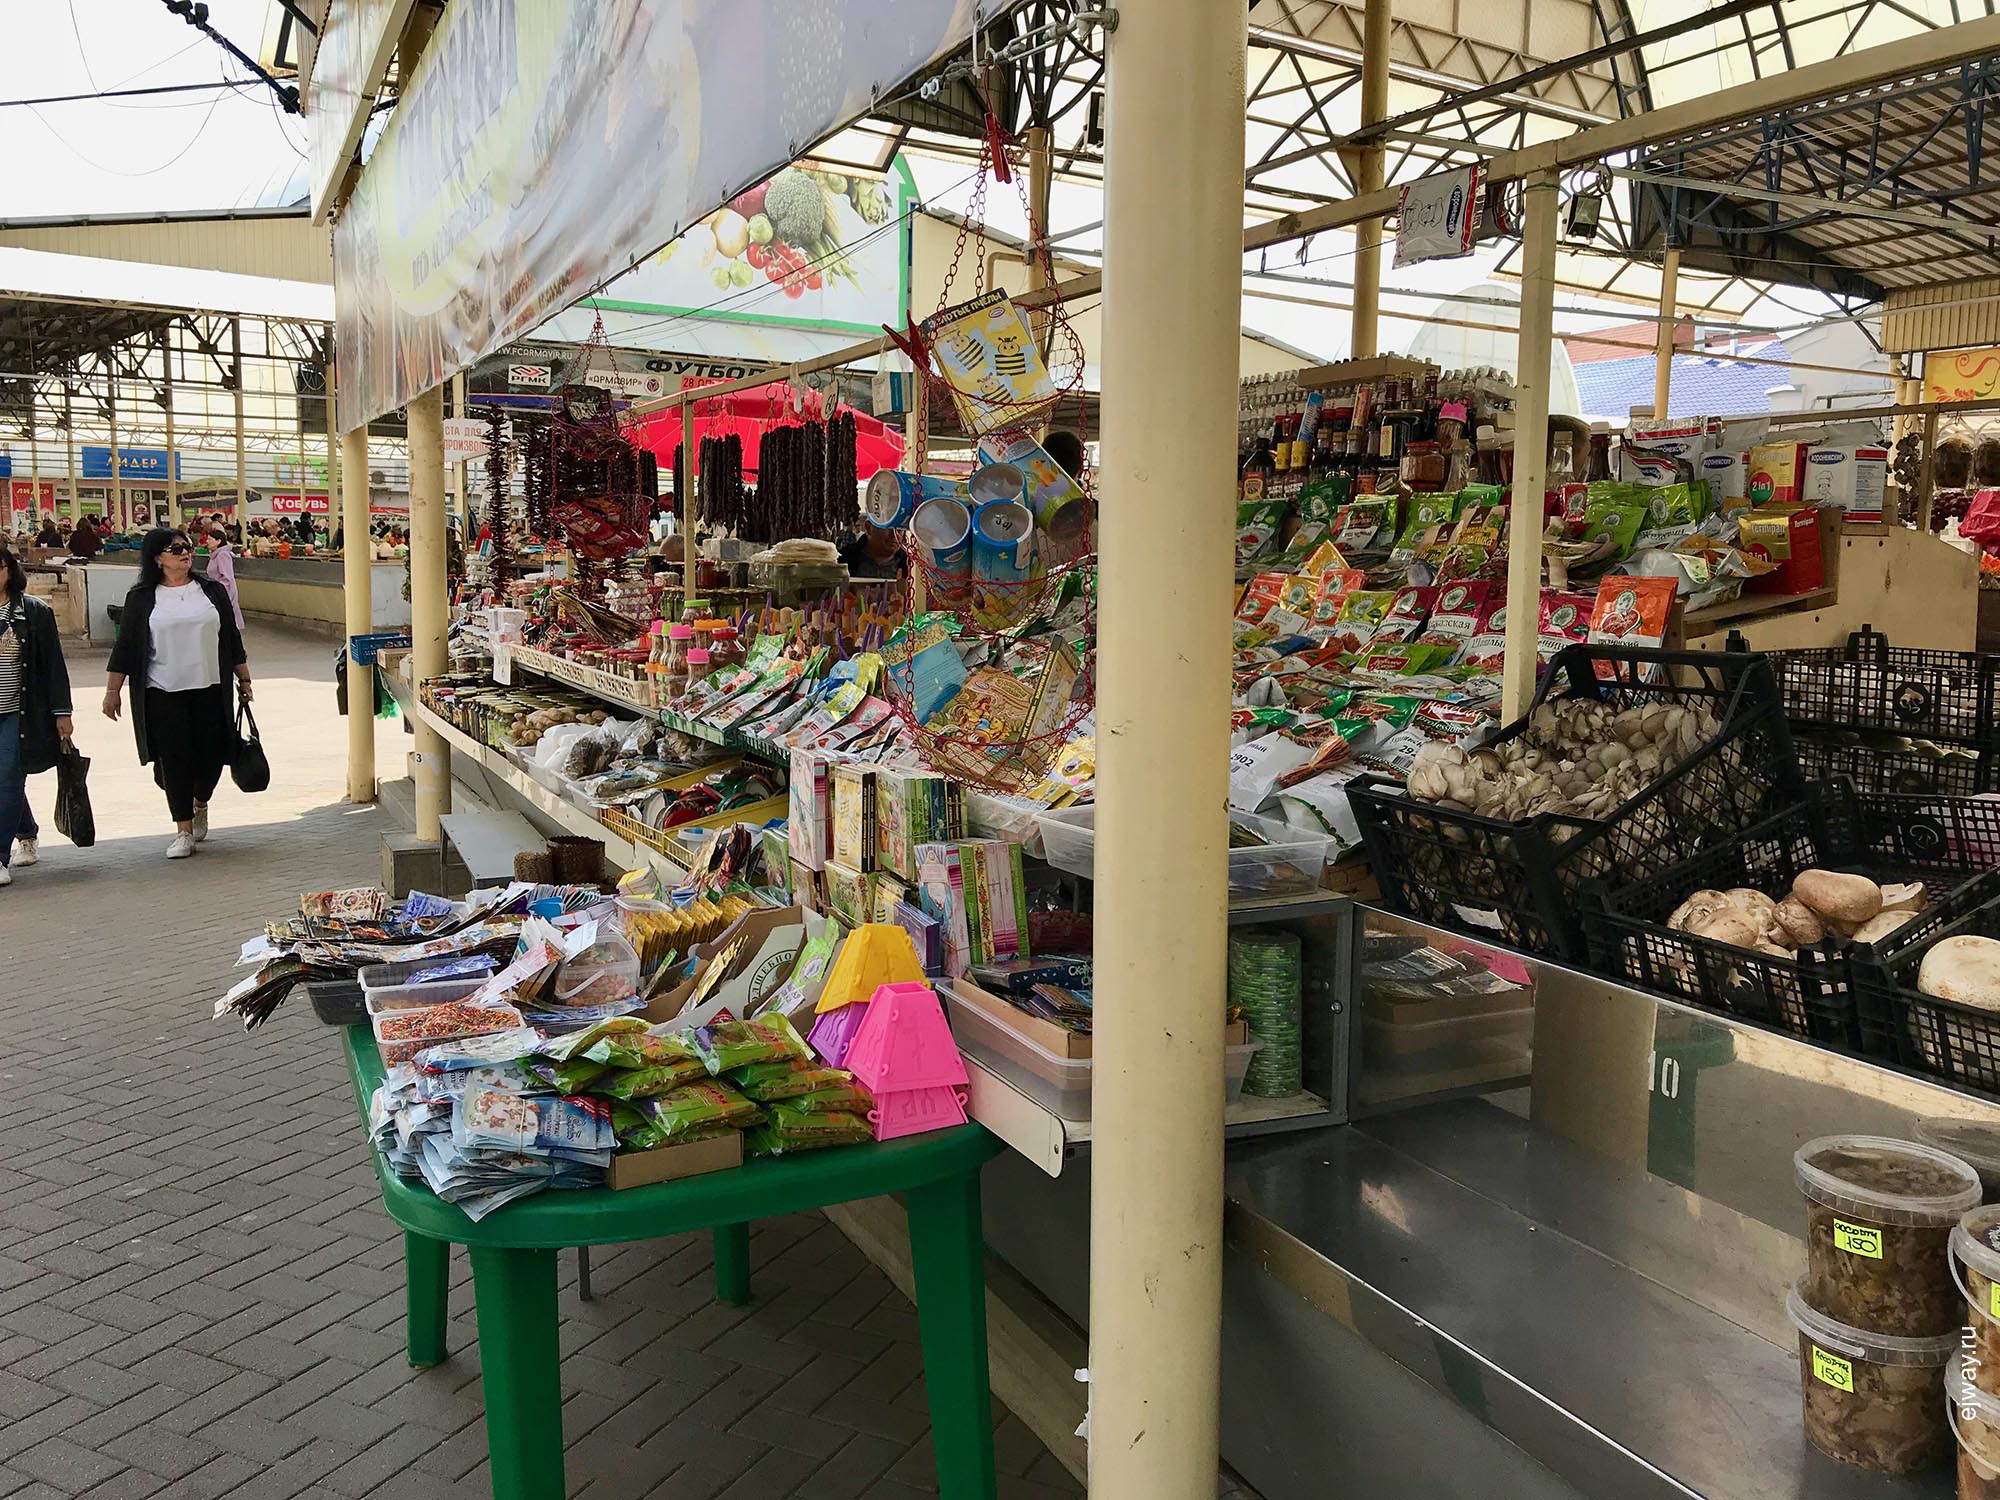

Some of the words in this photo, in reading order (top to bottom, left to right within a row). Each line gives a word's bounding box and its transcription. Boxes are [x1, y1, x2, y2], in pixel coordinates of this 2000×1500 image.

[511, 375, 547, 384] РГМК
[1752, 481, 1758, 492] 2
[416, 753, 422, 763] 3
[1648, 1050, 1680, 1099] 10
[1847, 1236, 1877, 1253] 150
[1821, 1365, 1846, 1386] 150
